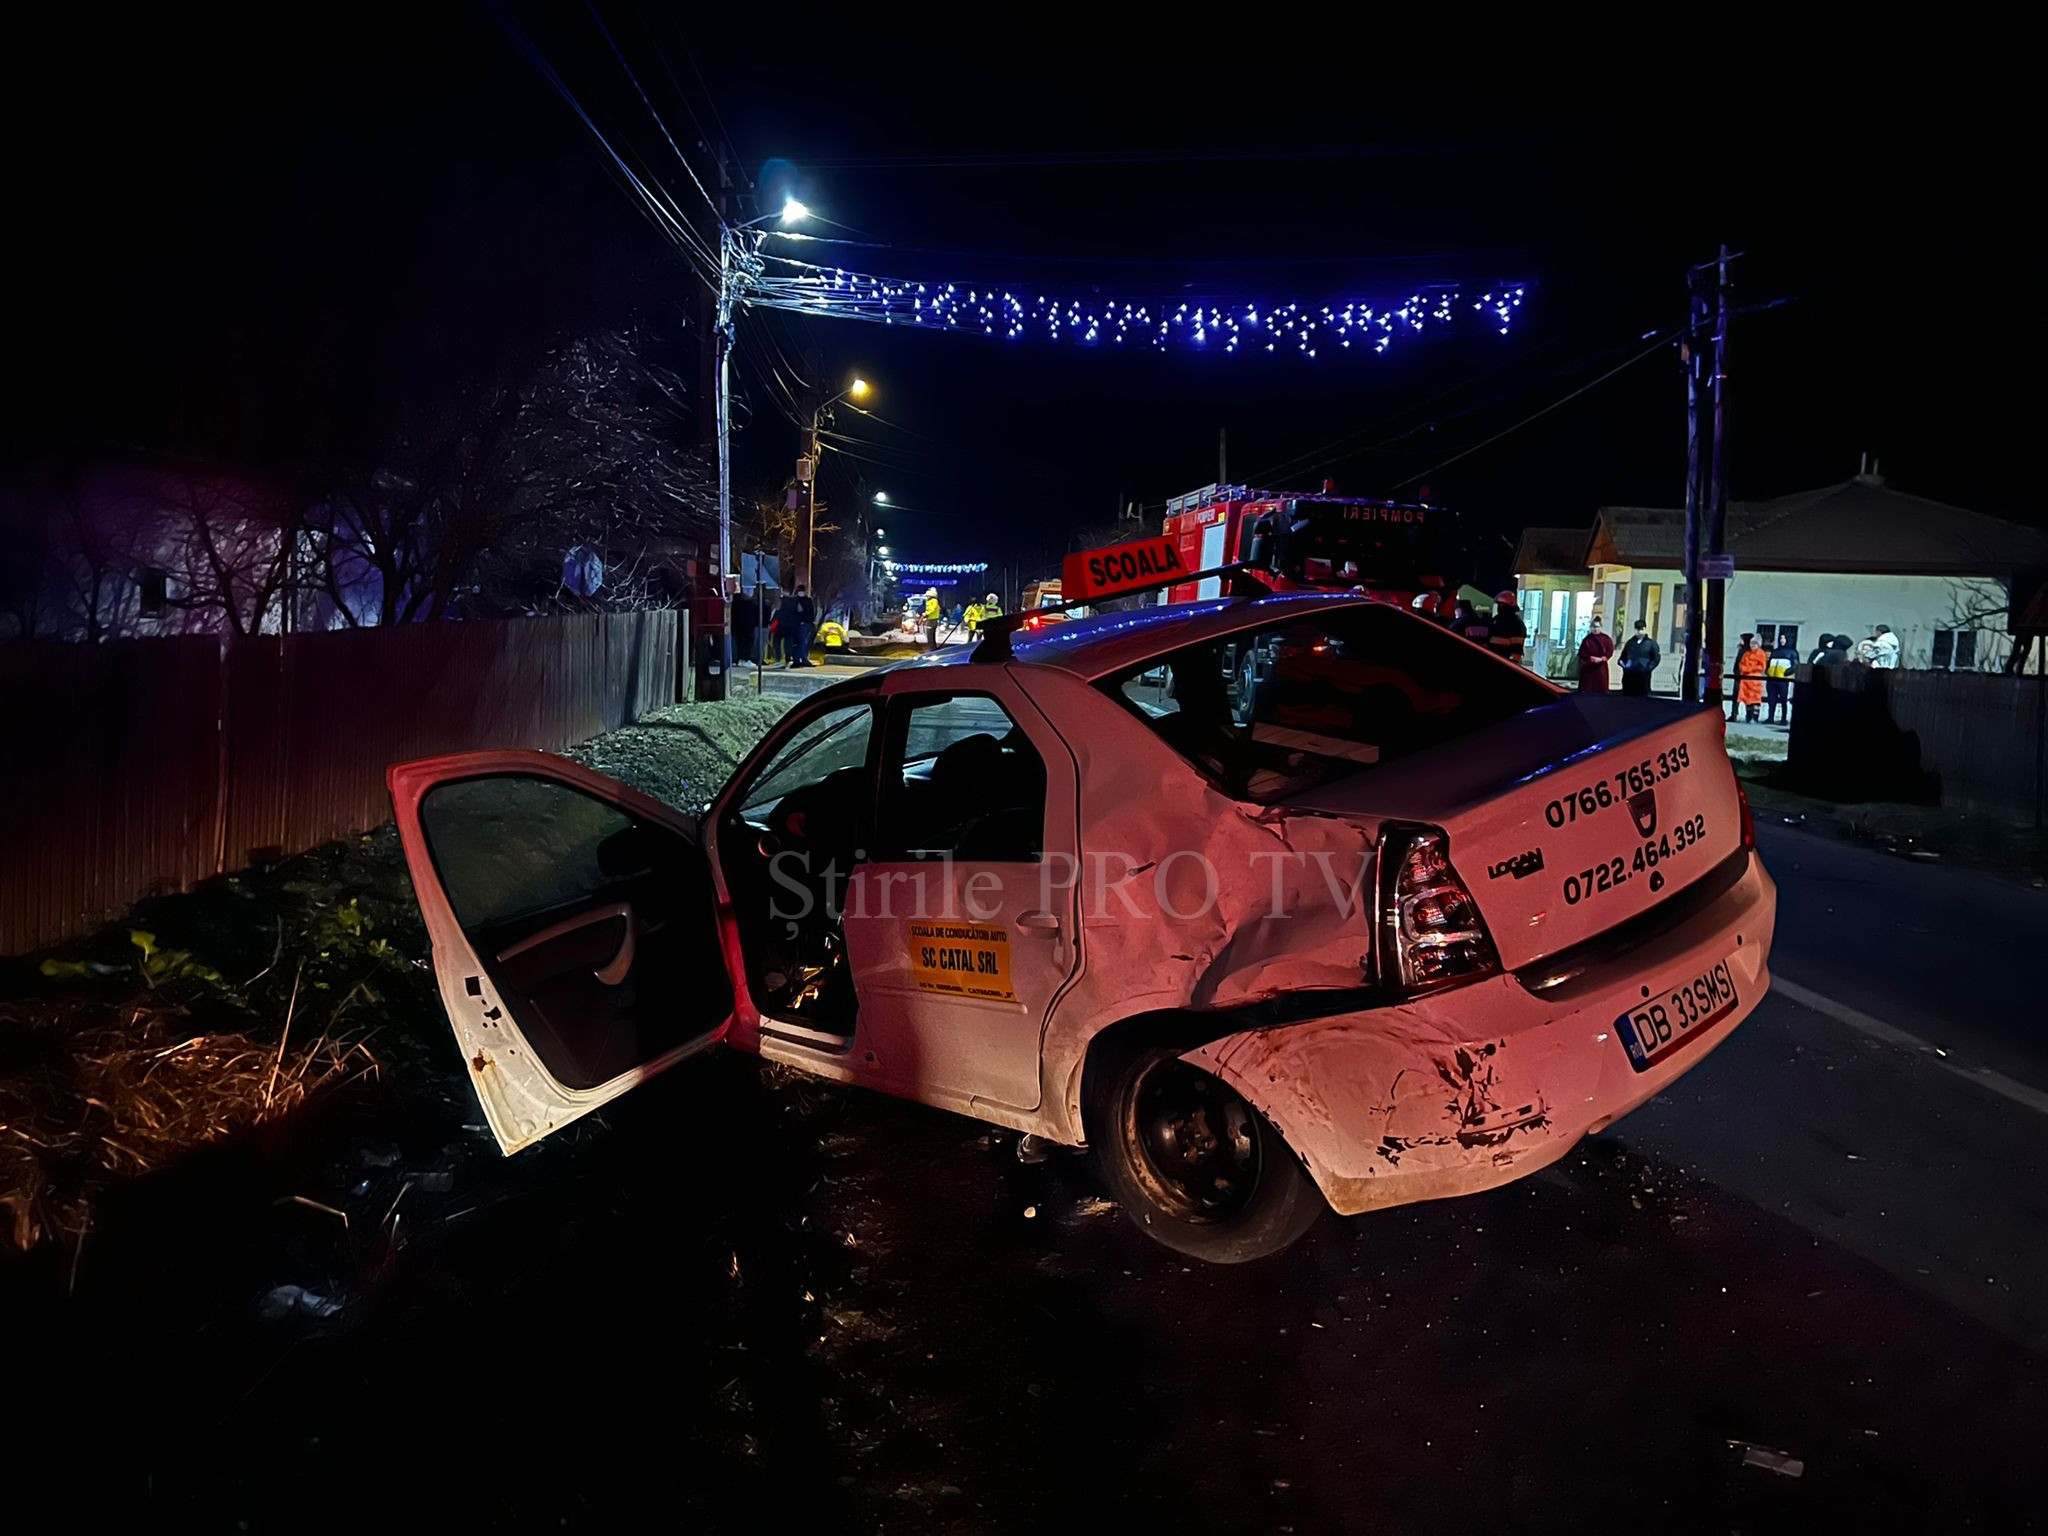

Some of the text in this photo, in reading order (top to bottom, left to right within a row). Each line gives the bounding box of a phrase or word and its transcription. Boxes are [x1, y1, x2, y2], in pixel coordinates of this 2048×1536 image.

[1090, 544, 1181, 587] SCOALA
[1545, 742, 1690, 829] 0766.765.339
[1488, 848, 1544, 880] LOGAN
[1563, 814, 1706, 905] 0722.464.392
[936, 927, 945, 938] DE
[990, 930, 1007, 942] AUTO
[921, 947, 998, 974] SC CATAL SRL
[1633, 1004, 1672, 1053] DB
